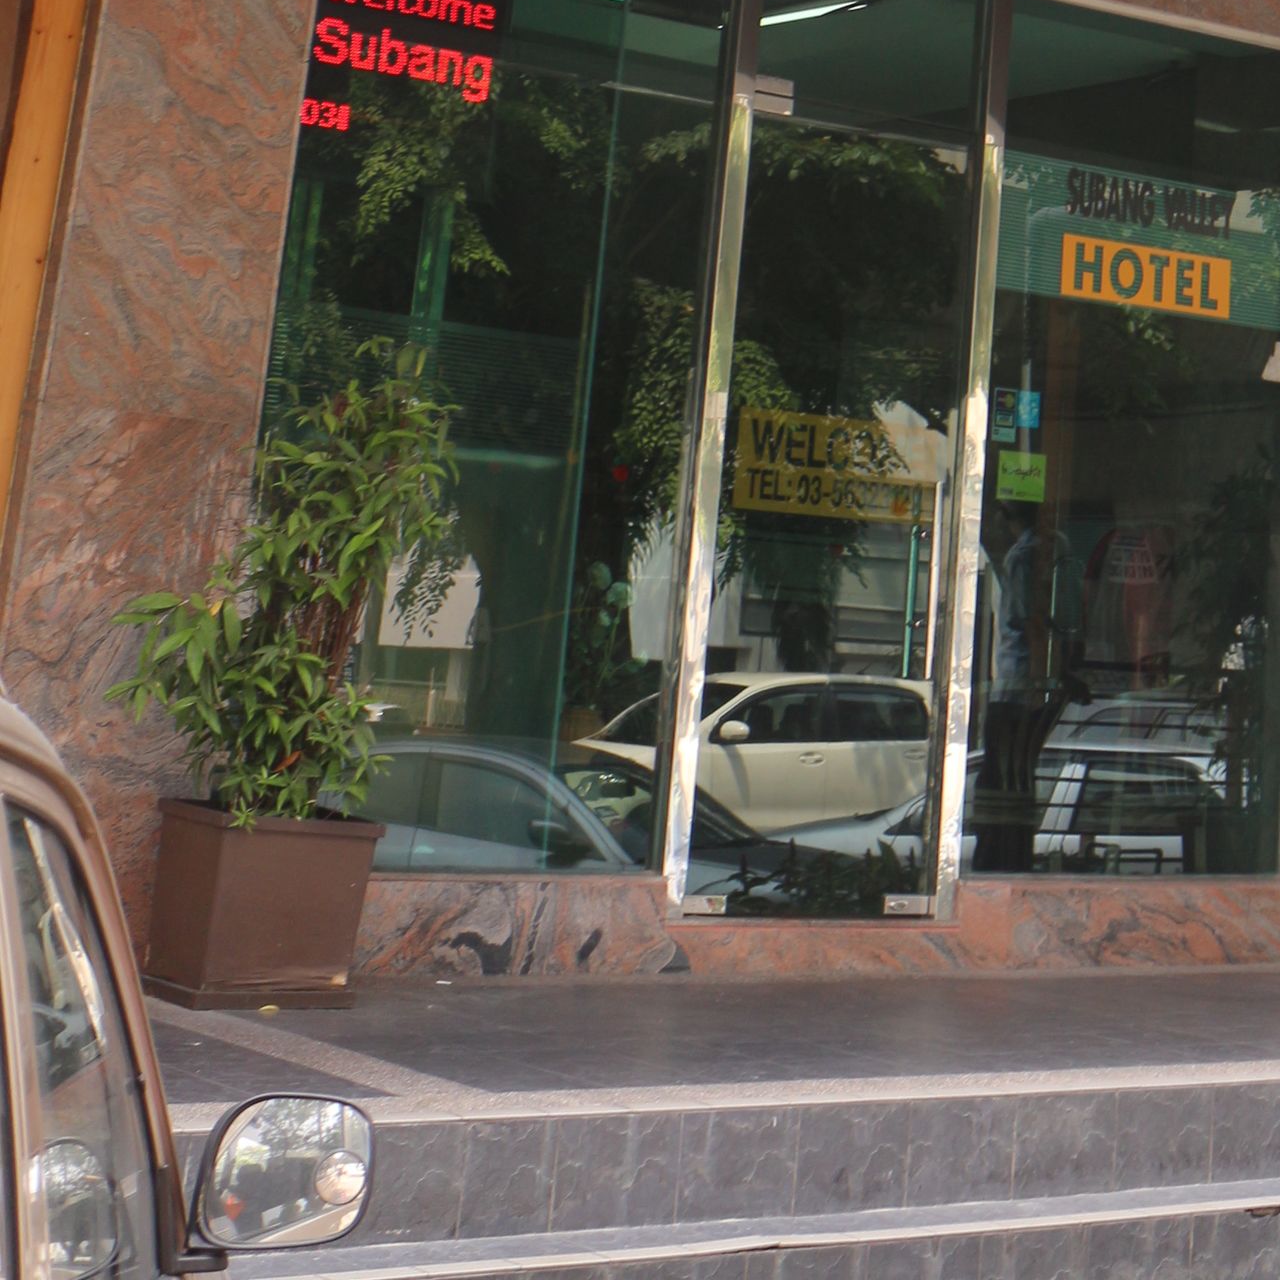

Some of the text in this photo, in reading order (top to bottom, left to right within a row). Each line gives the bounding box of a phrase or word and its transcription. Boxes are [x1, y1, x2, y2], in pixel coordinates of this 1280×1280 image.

[312, 16, 494, 104] Subang
[1066, 167, 1237, 240] SUBANG VALLEY
[1073, 241, 1218, 311] HOTEL
